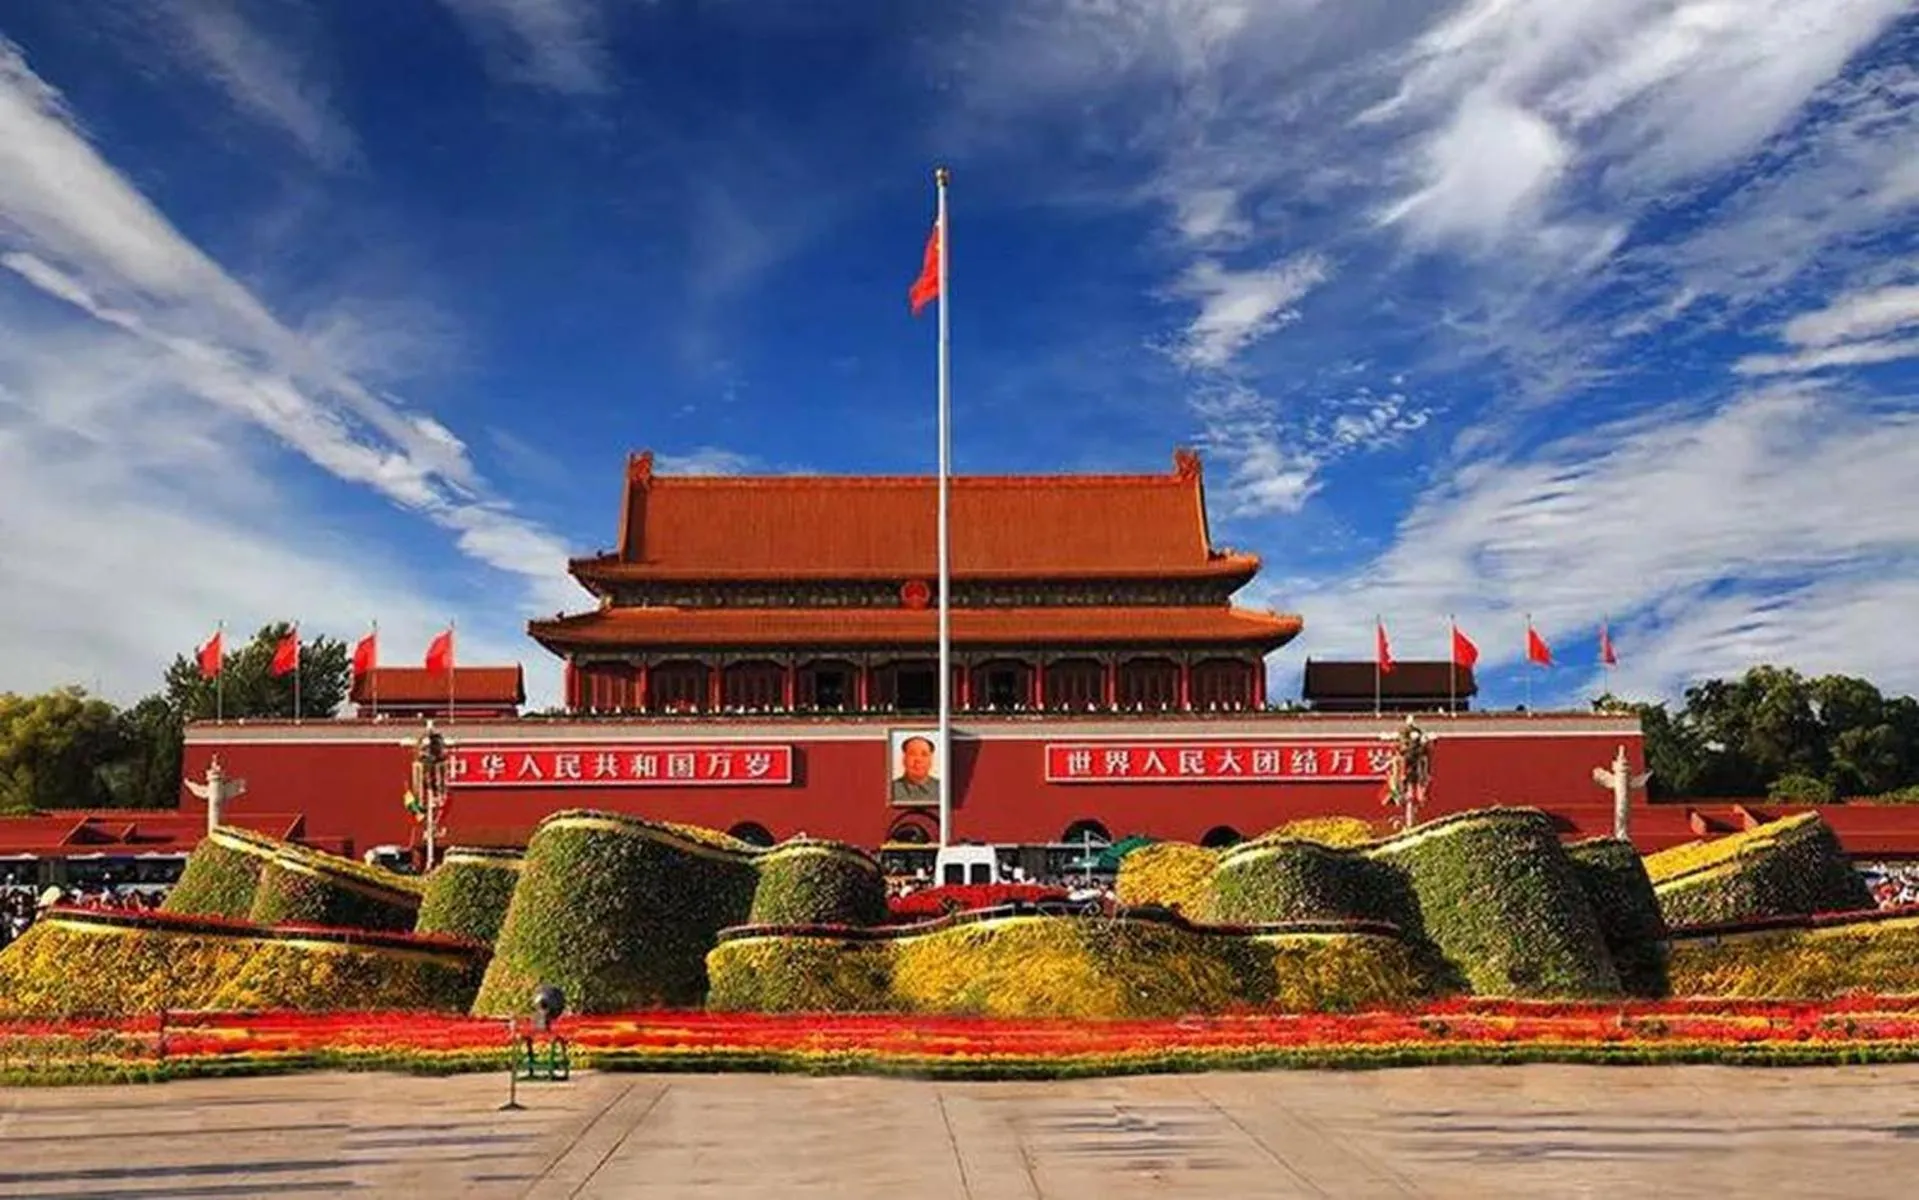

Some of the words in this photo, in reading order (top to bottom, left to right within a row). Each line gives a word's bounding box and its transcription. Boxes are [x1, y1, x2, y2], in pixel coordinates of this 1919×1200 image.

[446, 752, 771, 780] 中华人民共和国万岁
[1068, 749, 1395, 776] 世界人民大团结万岁
